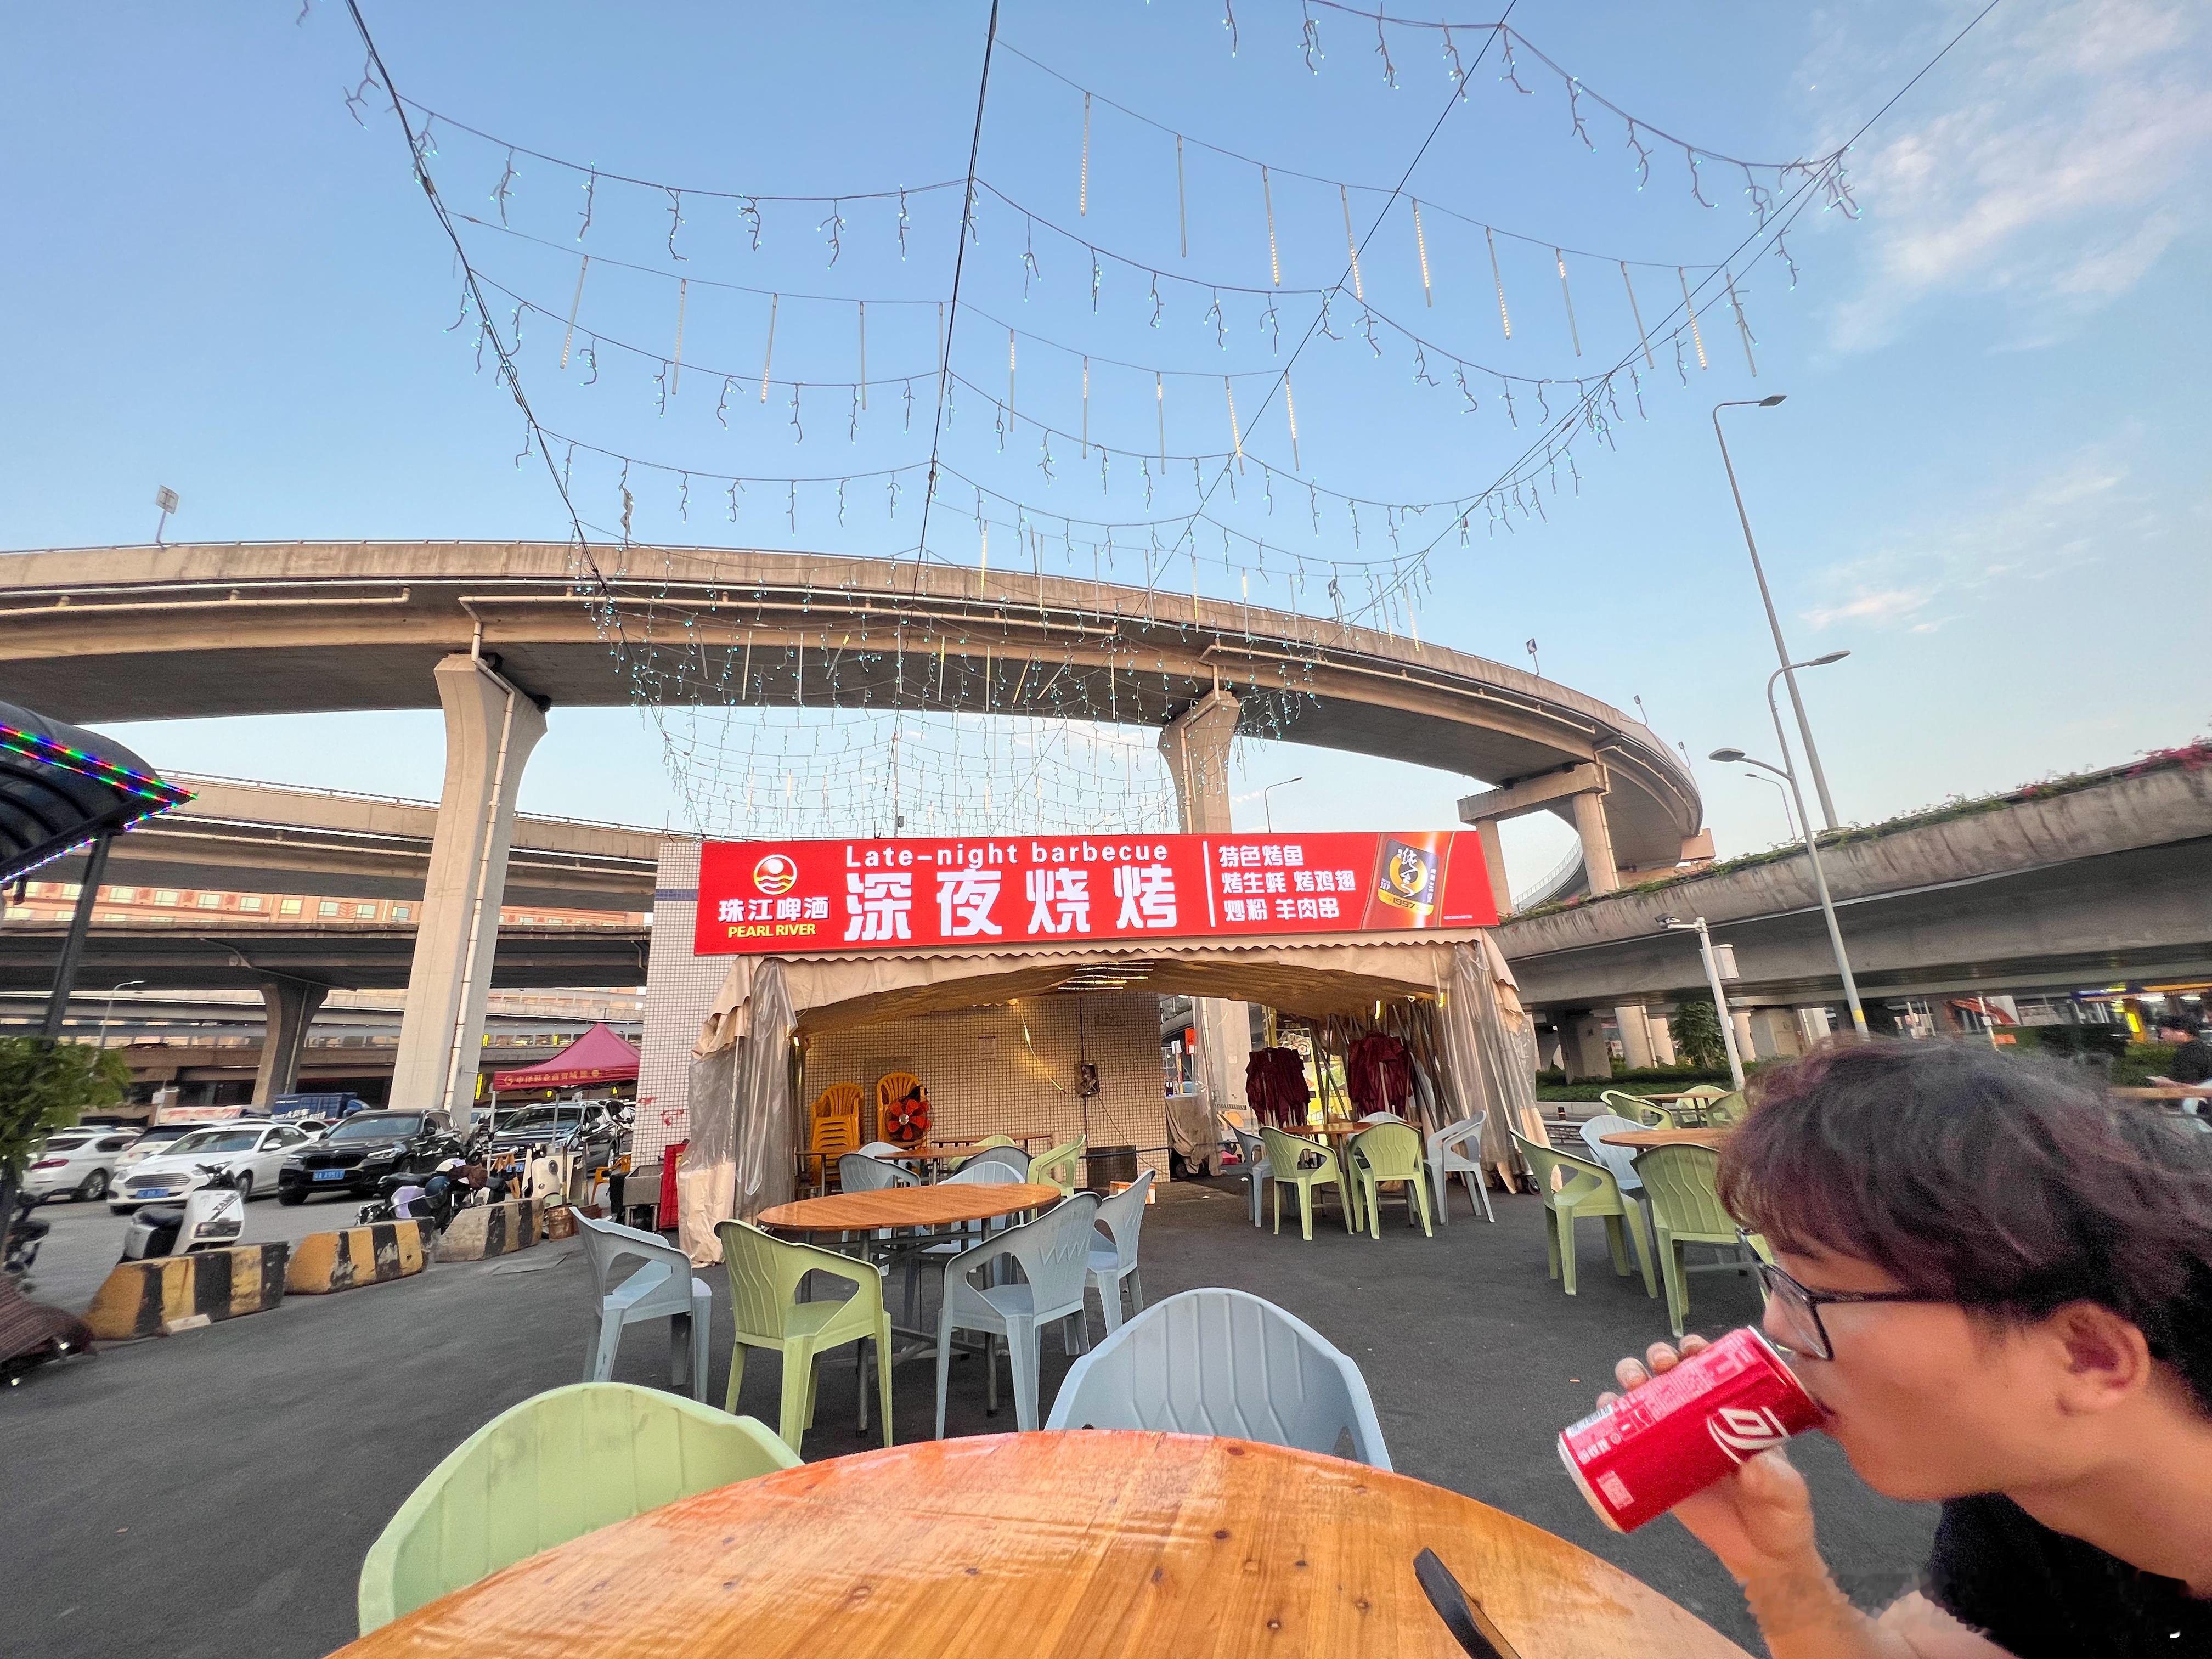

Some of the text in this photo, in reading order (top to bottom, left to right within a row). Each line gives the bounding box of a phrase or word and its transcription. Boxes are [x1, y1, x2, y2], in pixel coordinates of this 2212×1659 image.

[846, 840, 1169, 868] Late-night barbecue
[1218, 845, 1304, 867] 特色烤鱼
[1221, 871, 1287, 894] 烤生蚝
[1293, 870, 1356, 893] 烤鸡翅
[718, 896, 830, 923] 珠江啤酒
[844, 863, 1178, 942] 深夜烧烤
[1223, 897, 1340, 922] 炒粉 羊肉串
[1393, 898, 1415, 909] 1997
[727, 923, 816, 939] PEARL RIVER
